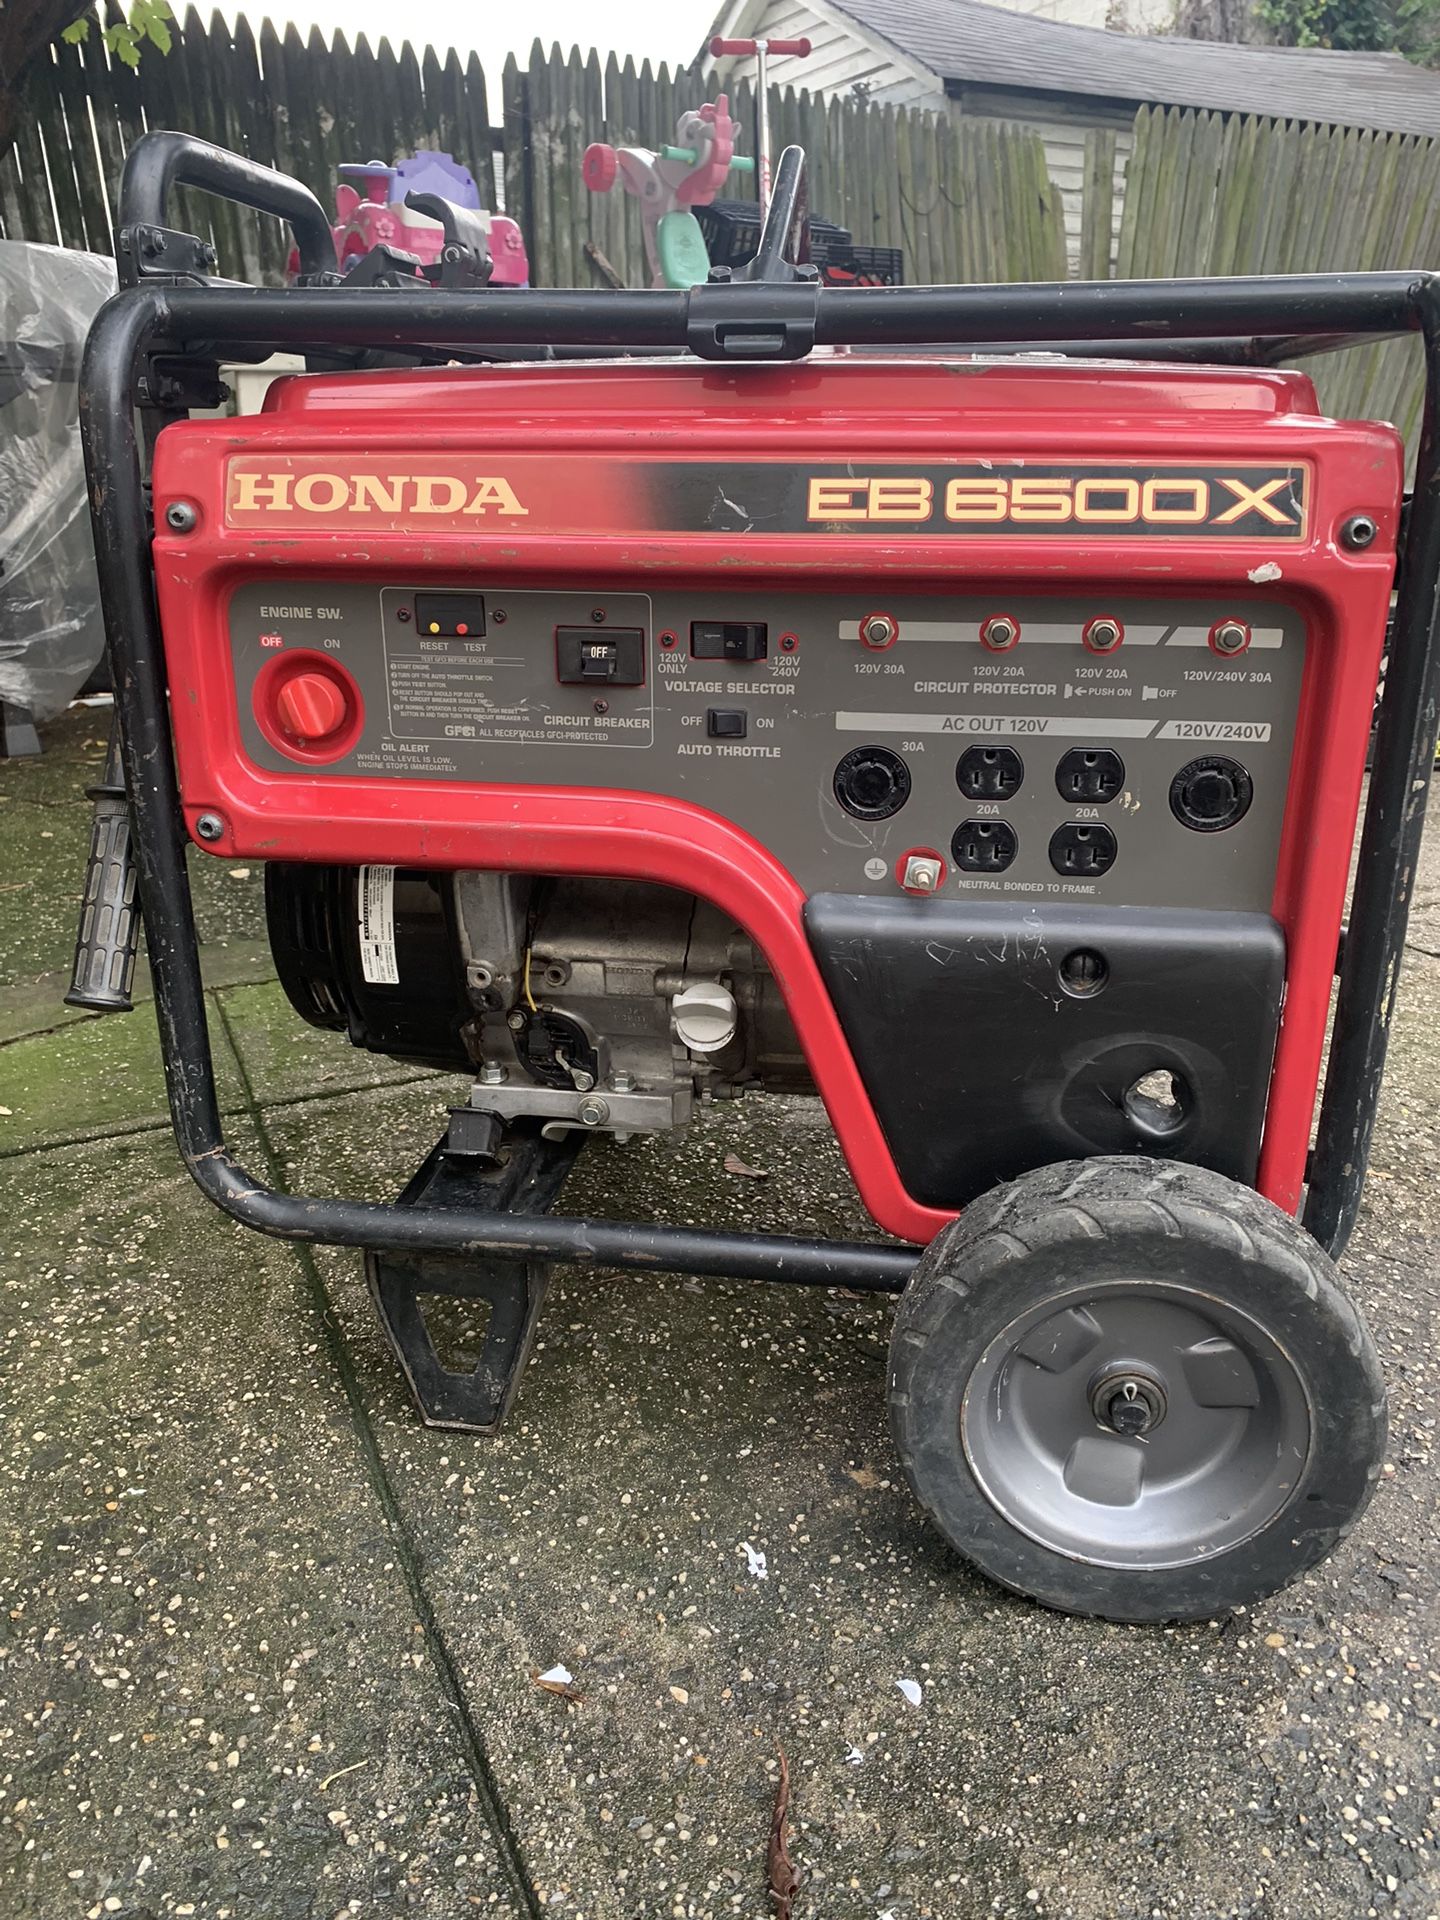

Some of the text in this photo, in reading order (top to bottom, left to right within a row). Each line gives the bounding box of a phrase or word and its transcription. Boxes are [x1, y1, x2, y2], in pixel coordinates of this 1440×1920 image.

[233, 472, 529, 516] HONDA
[260, 606, 343, 620] ENGINE SW.
[261, 636, 283, 647] OFF
[323, 639, 341, 649] ON
[420, 641, 487, 652] RESET TEST
[590, 646, 608, 659] OFF
[658, 653, 687, 663] 120V
[773, 656, 800, 667] 120V
[657, 663, 688, 675] ONLY
[772, 667, 800, 678] 240V
[854, 664, 905, 675] 120V 30A
[972, 666, 1025, 677] 120V 20A
[1074, 668, 1128, 679] 120V 20A
[1183, 670, 1272, 683] 120V/240V 30A
[664, 680, 795, 695] VOLTAGE SELECTOR
[914, 681, 1056, 696] CIRCUIT PROTECTOR
[1088, 687, 1132, 697] PUSH ON
[1159, 689, 1178, 698] OFF
[544, 714, 650, 729] CIRCUIT BREAKER
[681, 715, 703, 726] OFF
[756, 718, 774, 729] ON
[942, 717, 1049, 733] AC OUT 120V
[480, 728, 493, 737] ALL
[494, 729, 545, 739] RECEPTACLES
[547, 731, 609, 741] GFCI-PROTECTED
[1174, 723, 1267, 740] 120V/240V
[381, 743, 430, 753] OIL ALERT
[677, 743, 781, 758] AUTO THROTTLE
[902, 741, 925, 752] 30A
[357, 753, 380, 761] WHEN
[382, 754, 396, 762] OIL
[397, 755, 421, 763] LEVEL
[357, 761, 384, 769] ENGINE
[386, 762, 409, 770] STOPS
[976, 805, 1000, 815] 20A
[1075, 807, 1100, 819] 20A
[958, 880, 1002, 890] NEUTRAL
[1003, 881, 1044, 892] BONDED
[1047, 883, 1060, 893] TO
